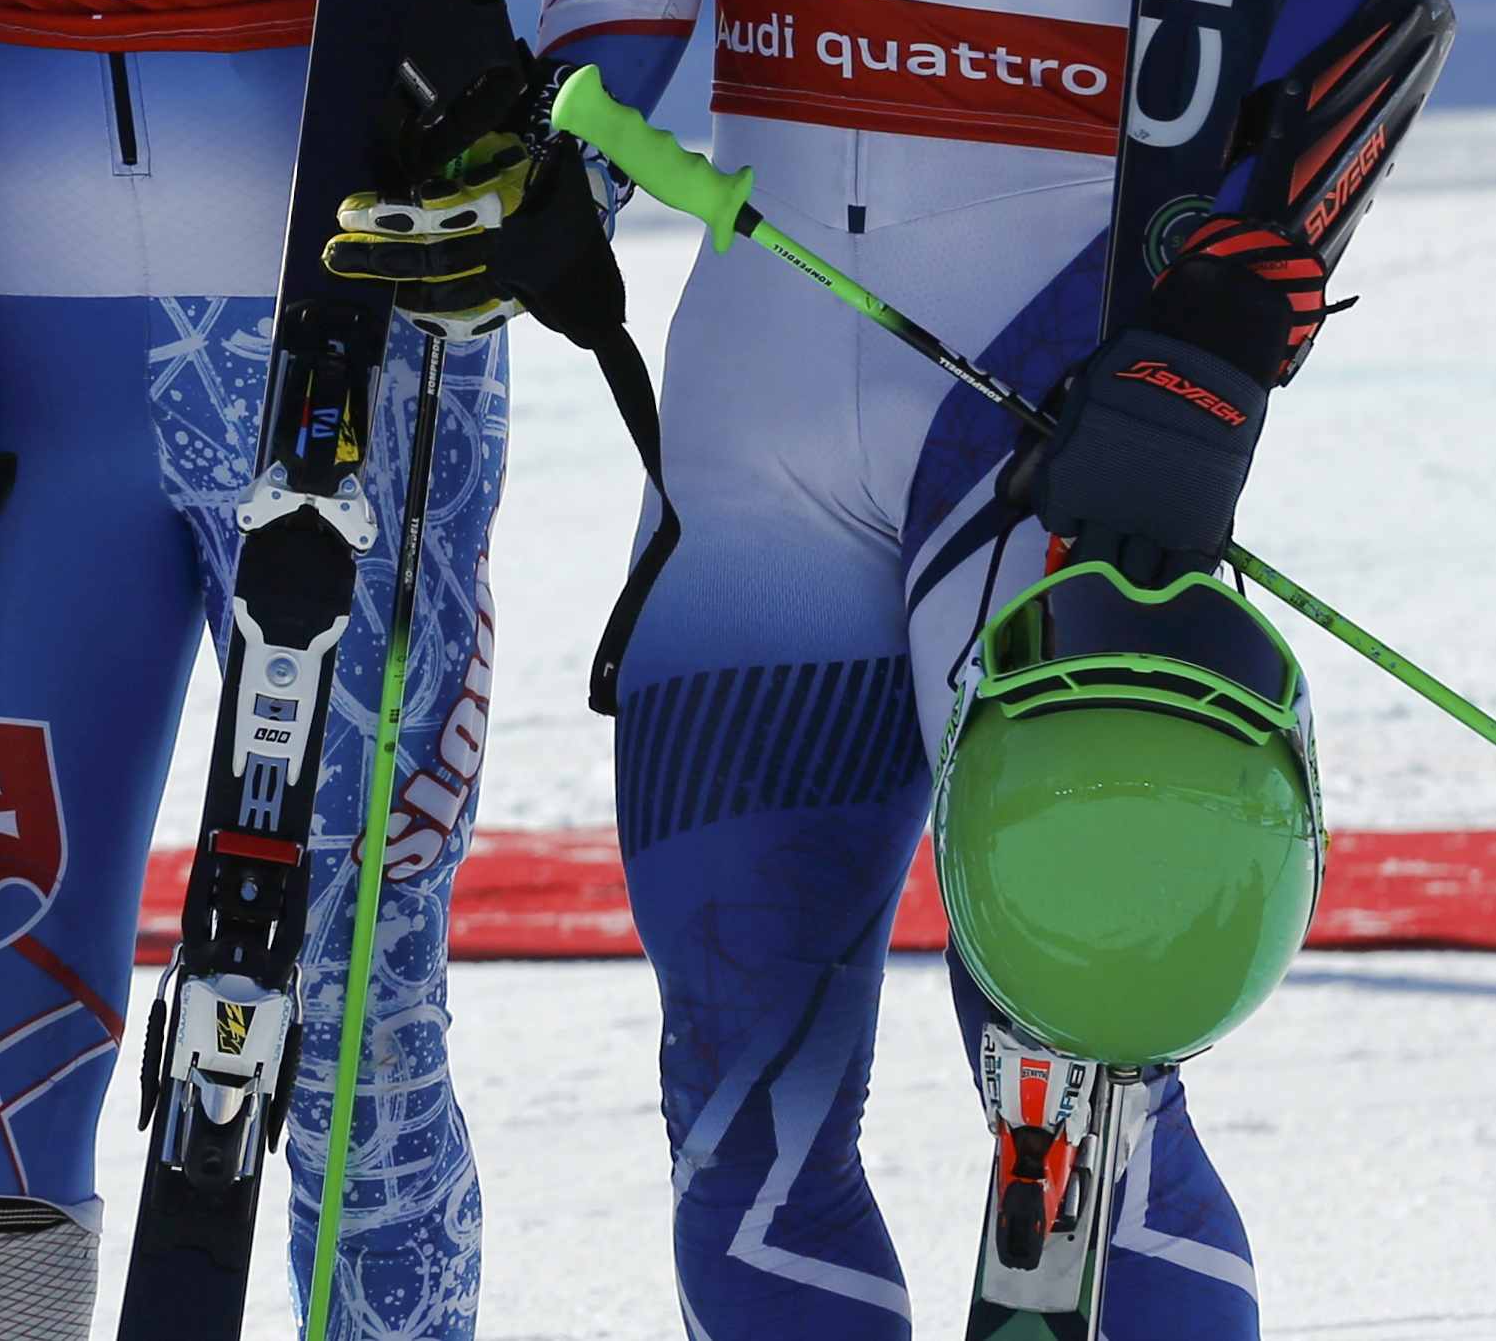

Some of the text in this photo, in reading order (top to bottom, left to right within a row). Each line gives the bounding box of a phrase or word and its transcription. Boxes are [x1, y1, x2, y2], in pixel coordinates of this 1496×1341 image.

[715, 12, 1108, 97] Audi quattro
[426, 338, 441, 396] KOMPERDE
